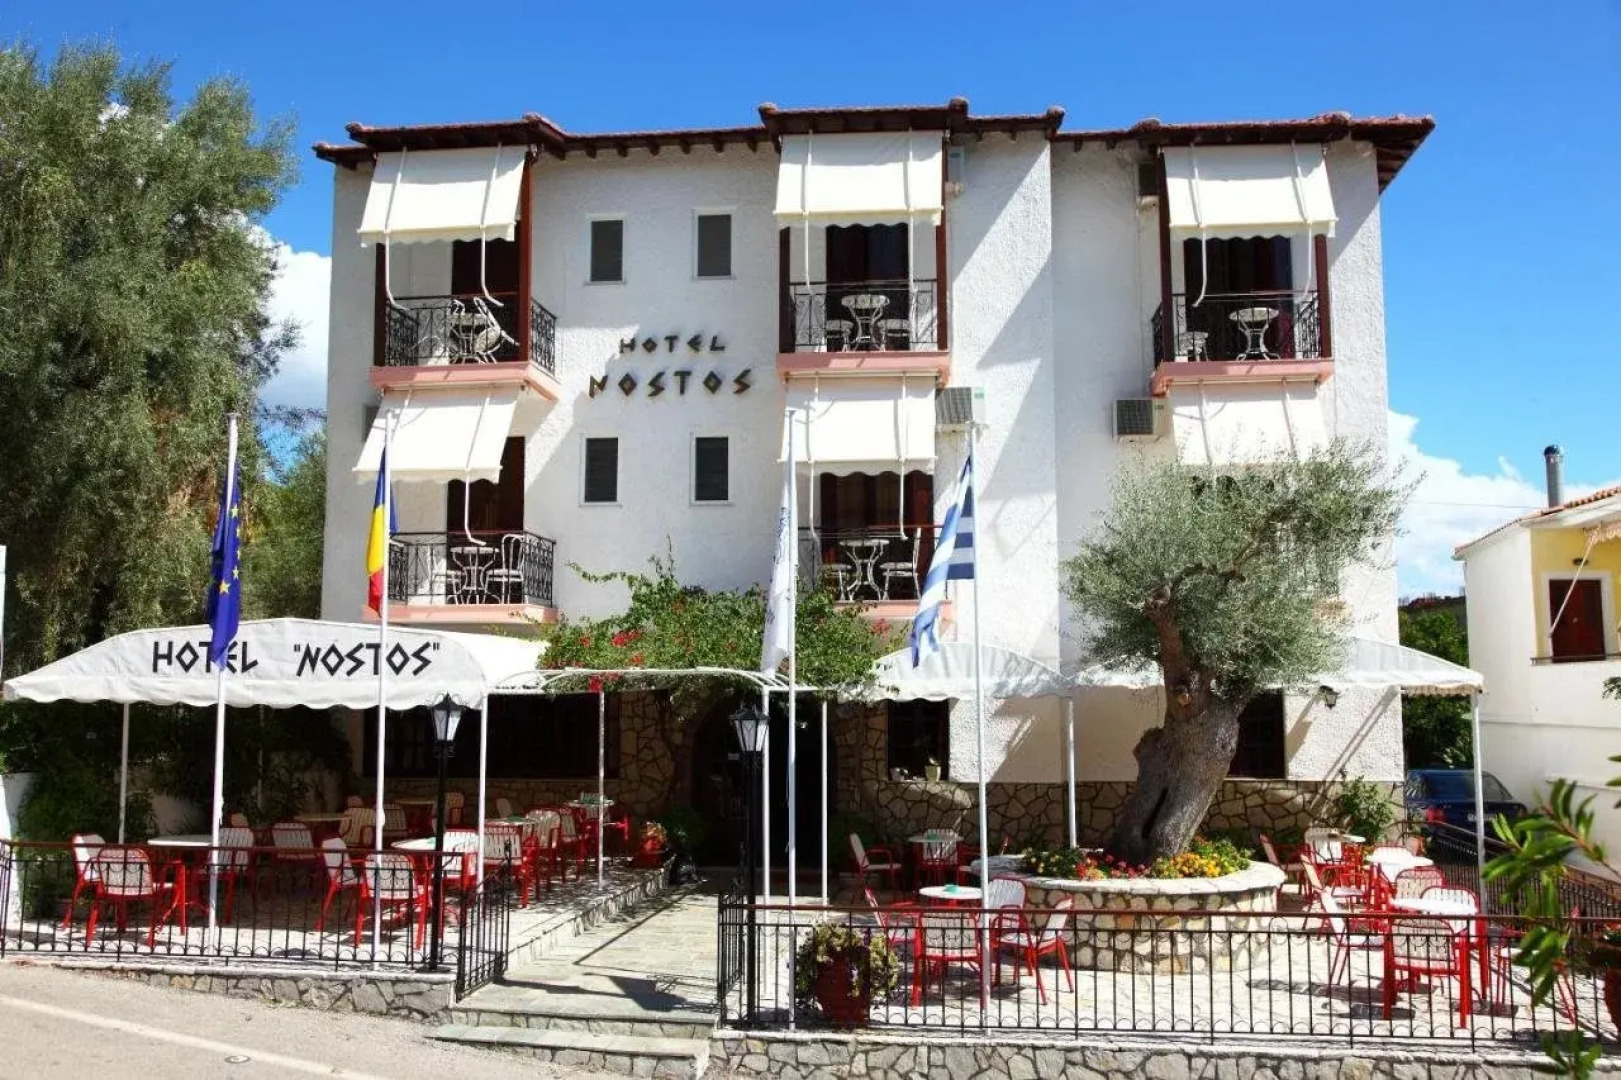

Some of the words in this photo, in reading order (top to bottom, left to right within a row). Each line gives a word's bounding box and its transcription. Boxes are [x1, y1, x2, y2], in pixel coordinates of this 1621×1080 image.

[619, 334, 726, 354] HOTEL
[588, 368, 753, 399] NOSTOS
[152, 641, 259, 674] HOTEL
